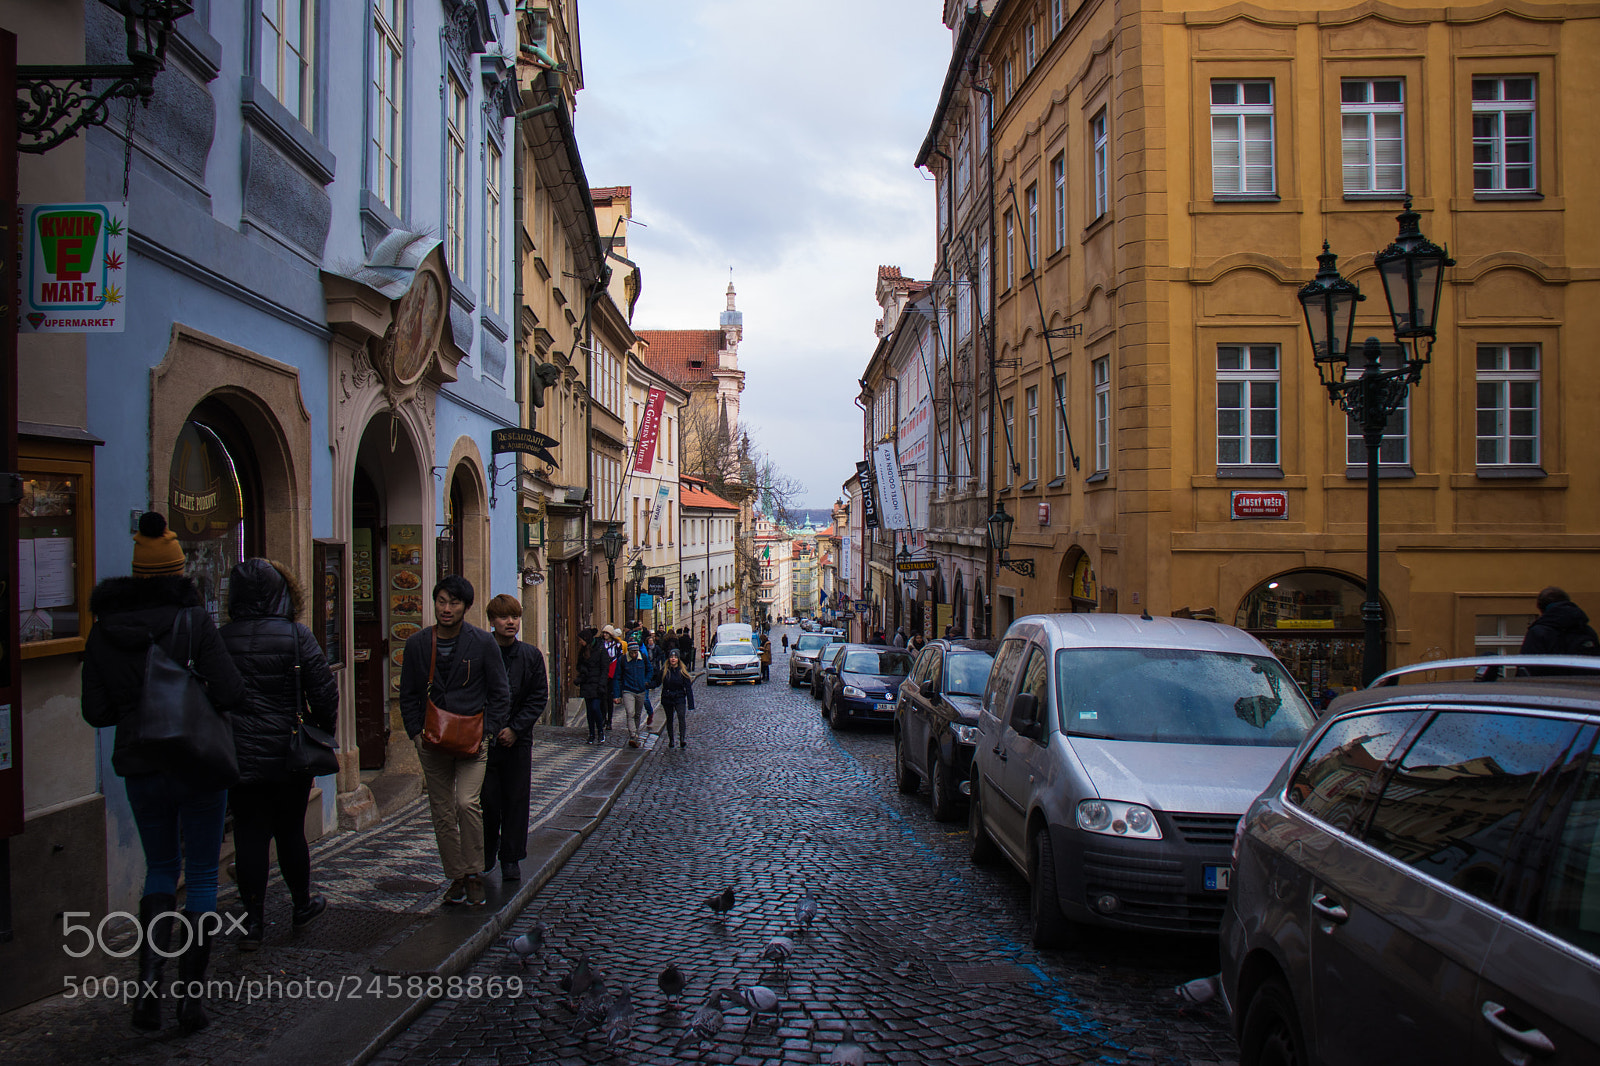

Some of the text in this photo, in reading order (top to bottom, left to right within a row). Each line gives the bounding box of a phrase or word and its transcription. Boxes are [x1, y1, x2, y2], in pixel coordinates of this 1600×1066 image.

[41, 216, 97, 237] KWIK
[56, 238, 82, 281] E
[642, 409, 655, 439] GOLDEN
[636, 438, 650, 465] WHEEL
[886, 462, 896, 490] GOLDEN
[859, 470, 874, 516] VISITOR
[890, 490, 899, 511] HOTEL
[1238, 497, 1283, 507] JÁNSKÝ VRŠEK
[654, 504, 662, 521] MARE
[899, 562, 935, 570] RESTAURANT
